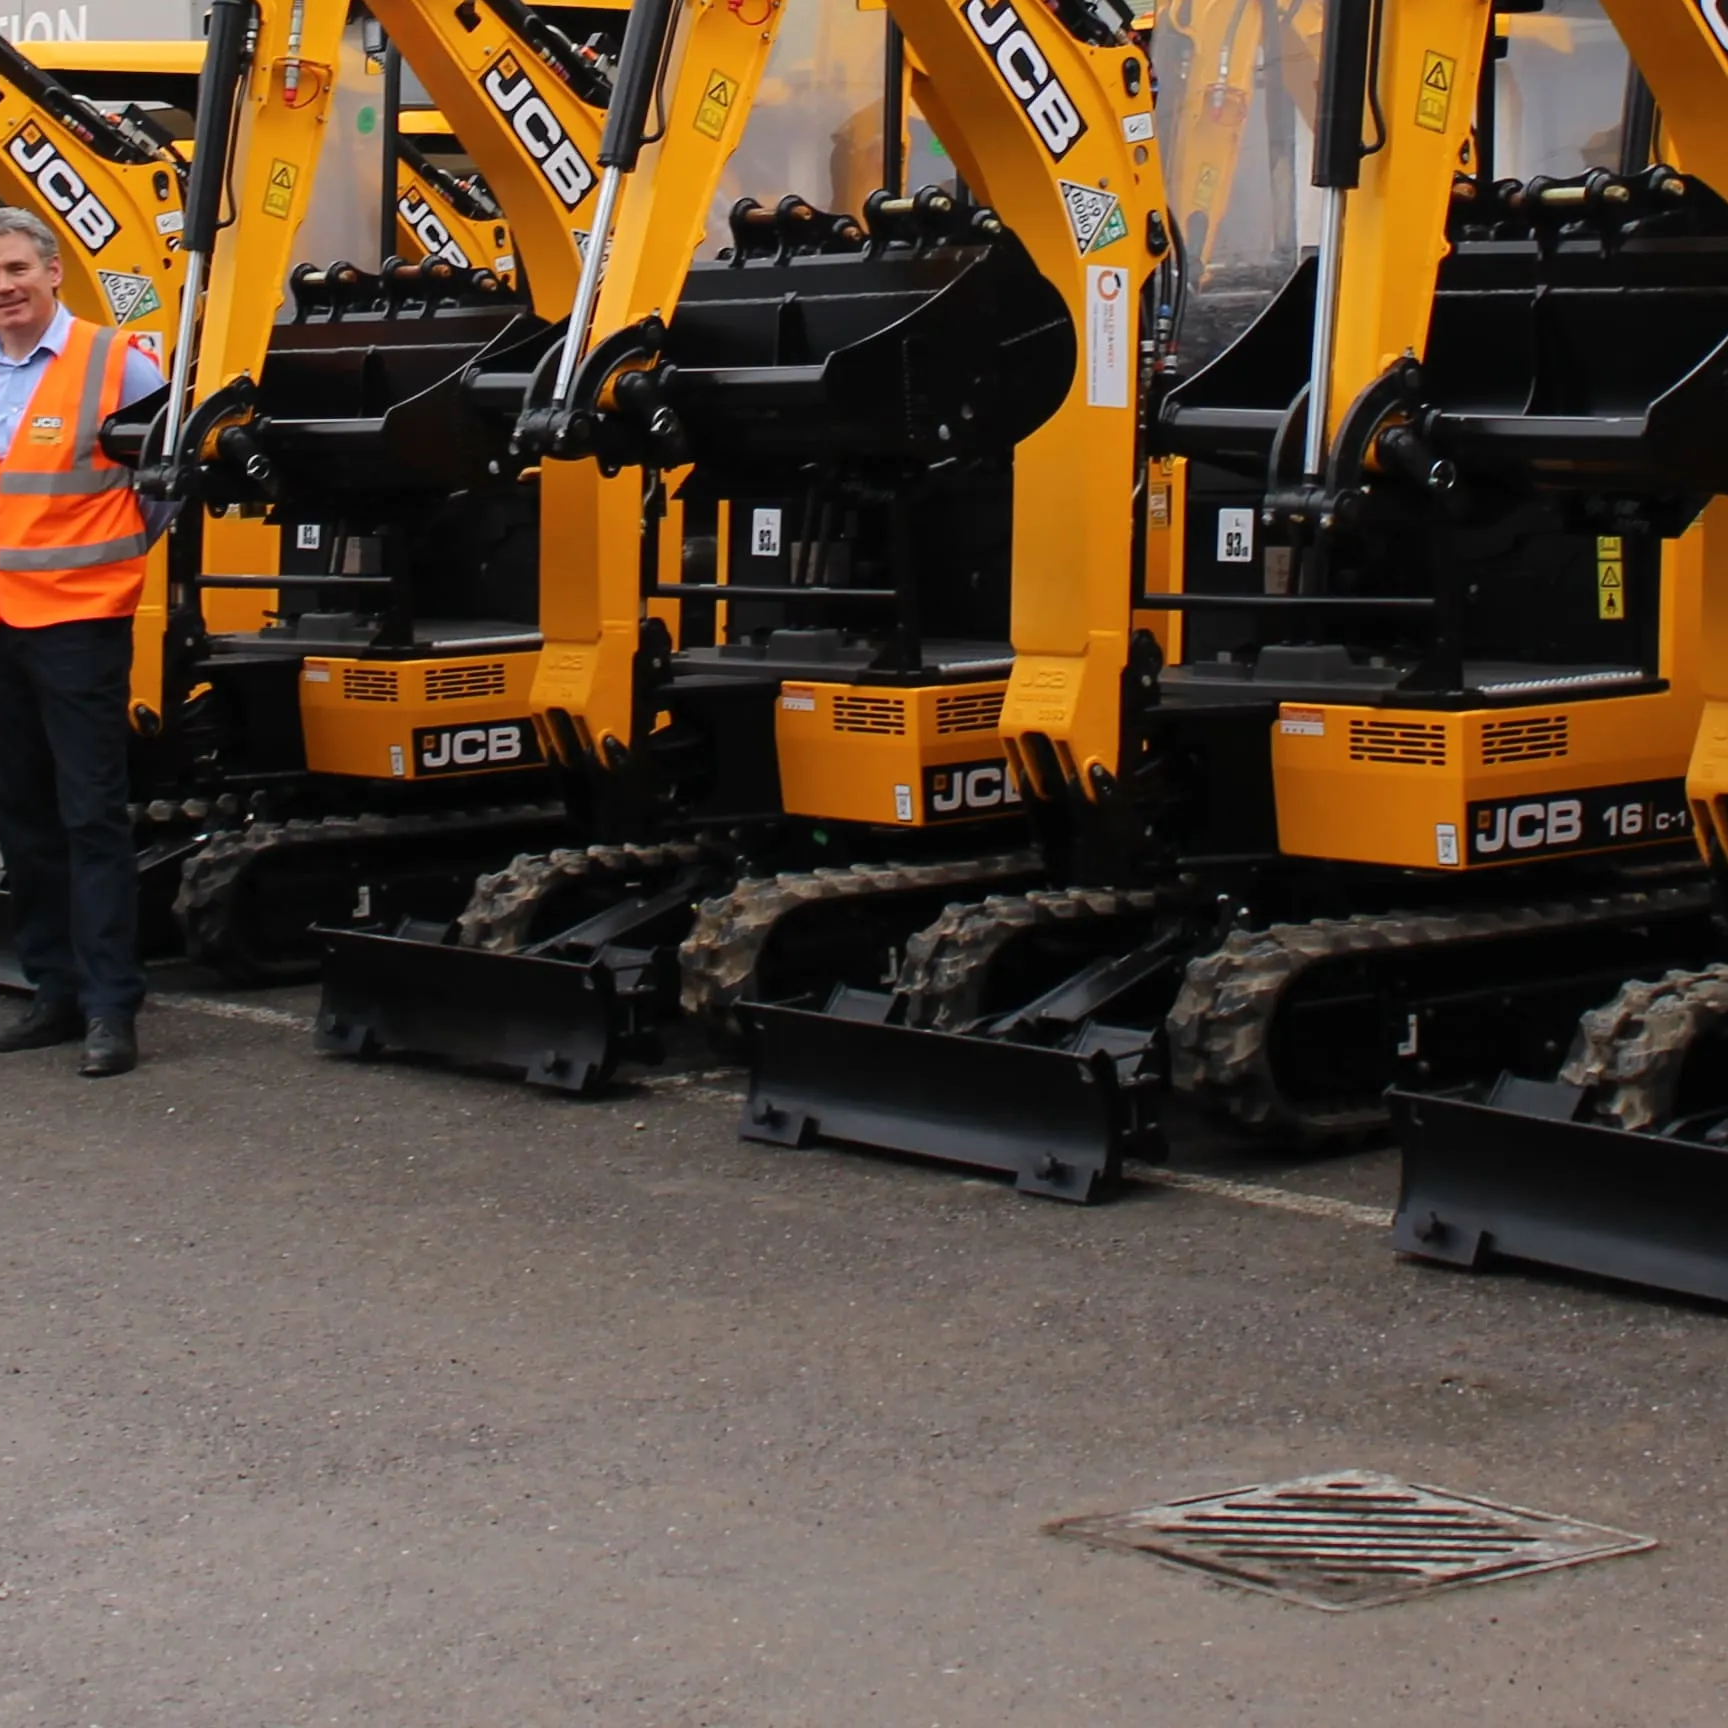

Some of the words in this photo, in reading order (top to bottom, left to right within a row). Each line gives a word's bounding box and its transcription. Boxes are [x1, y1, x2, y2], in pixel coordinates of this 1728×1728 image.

[485, 69, 593, 205] JCB
[10, 136, 115, 250] JCB
[423, 726, 522, 767] JCB
[1476, 799, 1582, 853] JCB
[1602, 803, 1643, 836] 16
